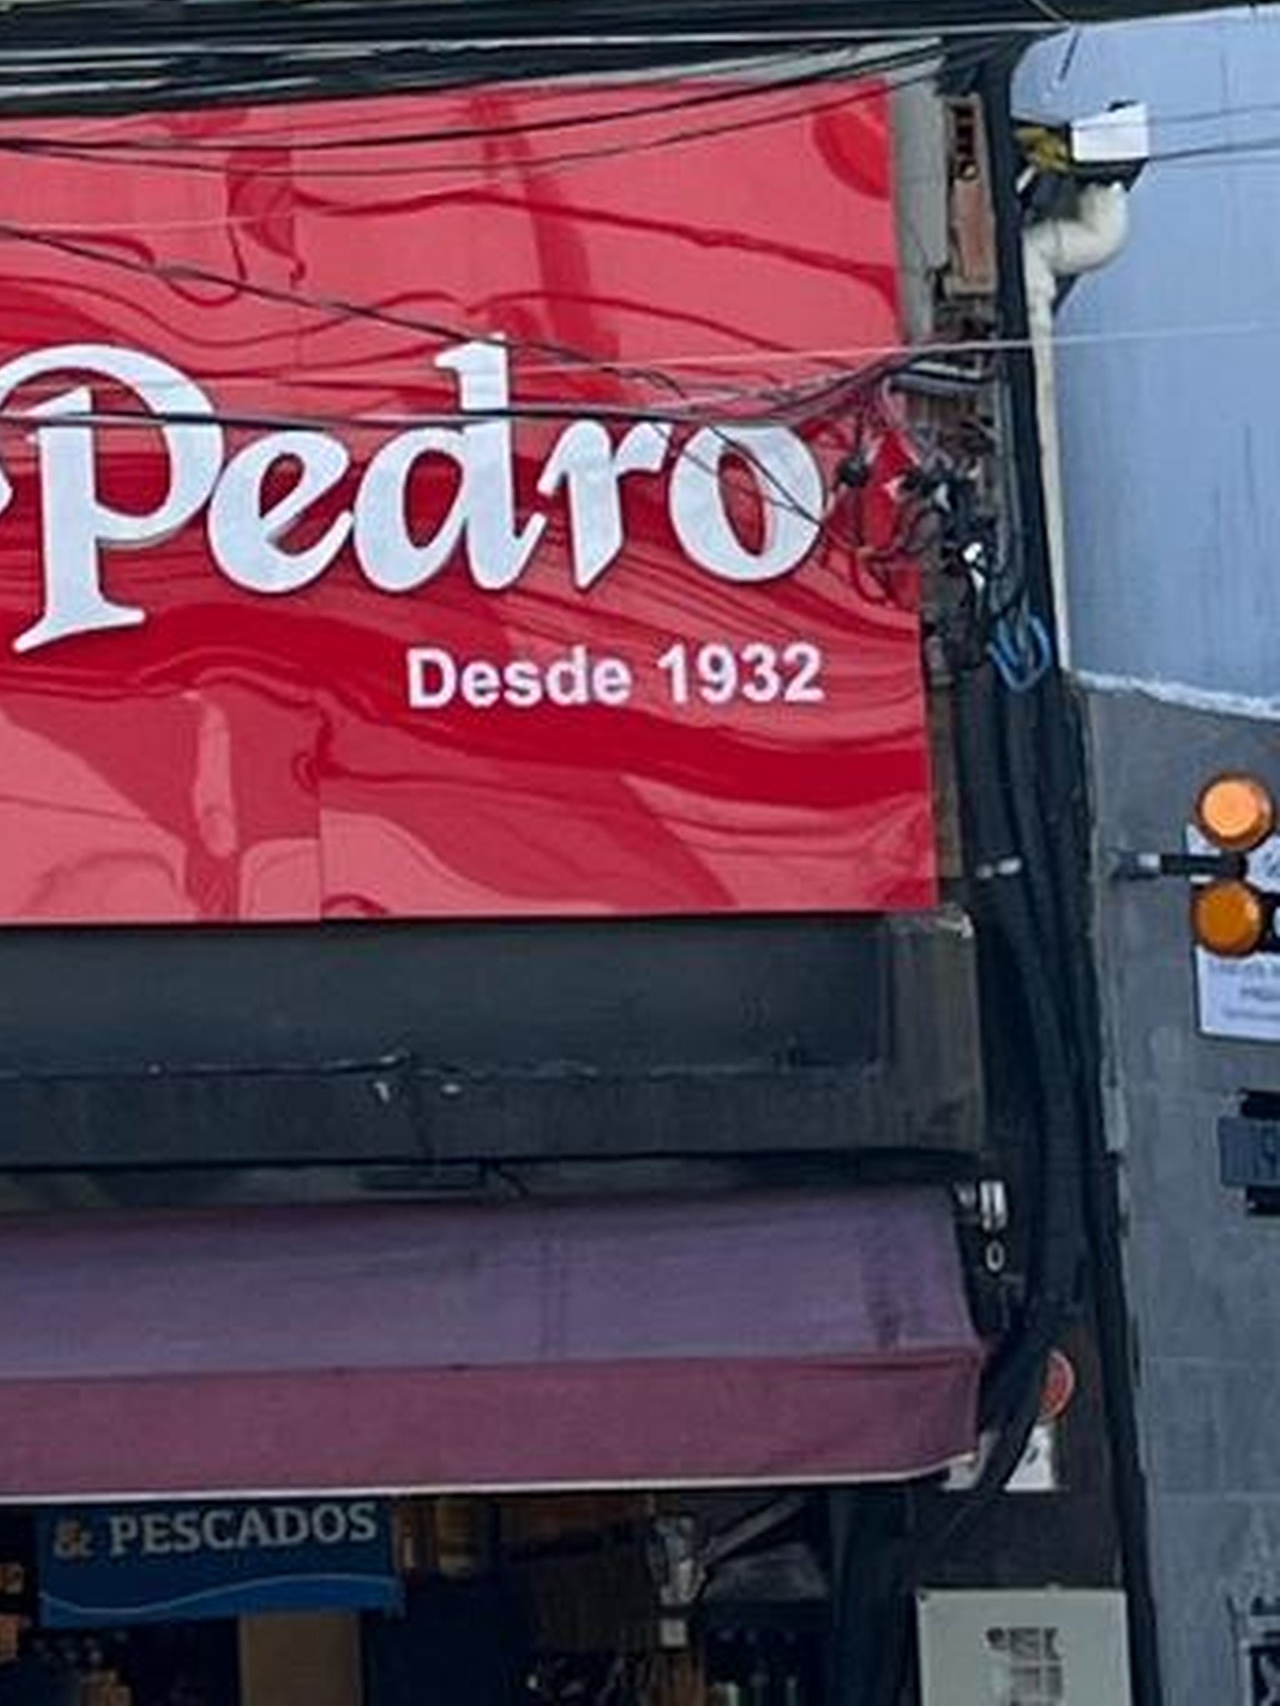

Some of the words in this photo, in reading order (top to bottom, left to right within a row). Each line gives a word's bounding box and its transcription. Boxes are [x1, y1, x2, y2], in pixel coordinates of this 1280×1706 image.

[405, 644, 632, 708] Desde
[657, 641, 826, 705] 1932
[109, 1500, 378, 1558] PESCADOS
